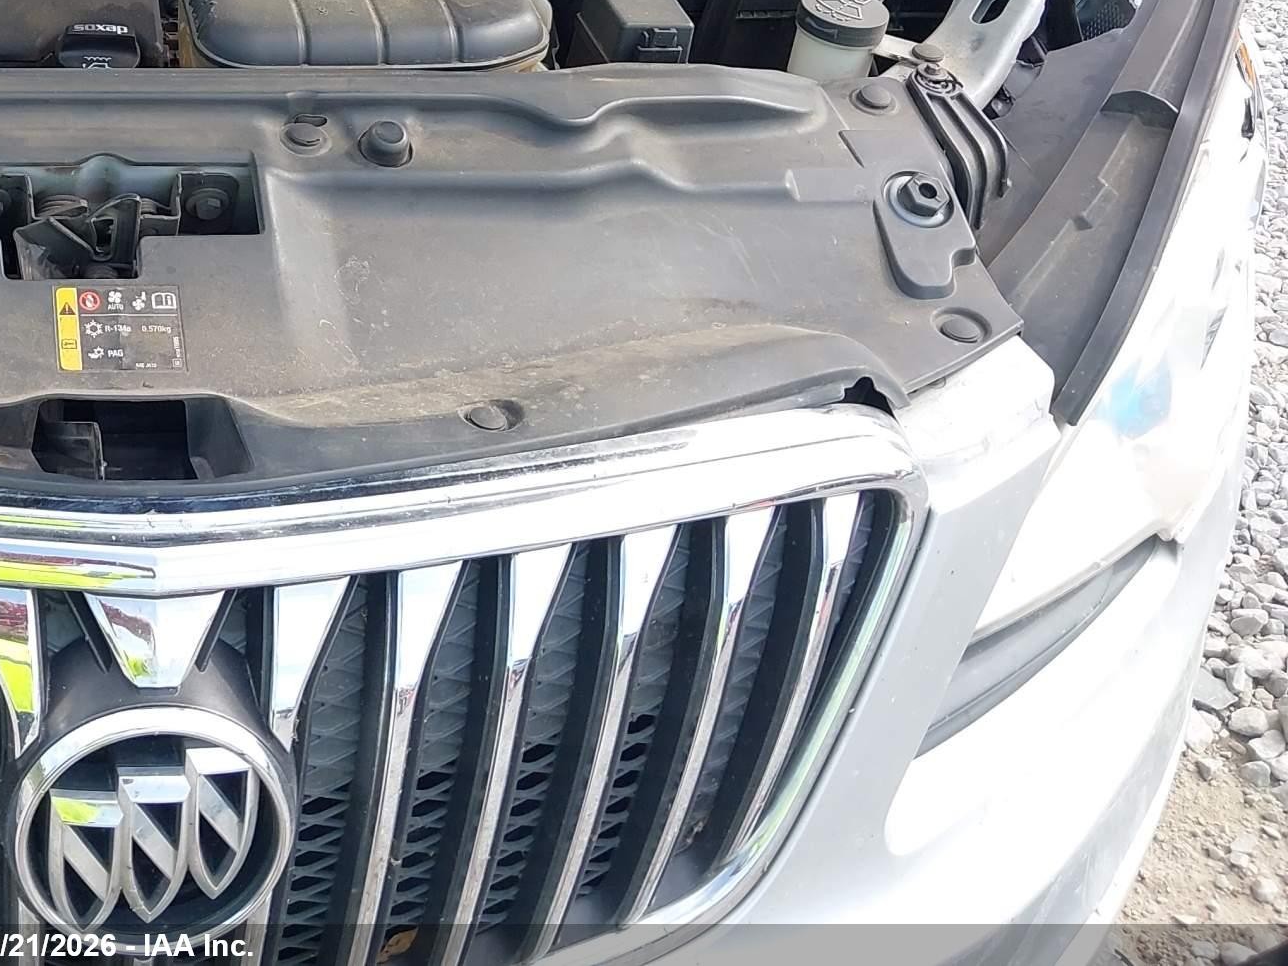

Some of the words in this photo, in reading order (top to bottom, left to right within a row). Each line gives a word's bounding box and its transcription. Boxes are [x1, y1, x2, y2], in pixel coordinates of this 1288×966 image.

[72, 23, 129, 35] dexos
[107, 303, 124, 311] AUTO
[104, 324, 132, 333] R-134a
[107, 348, 124, 358] PAG
